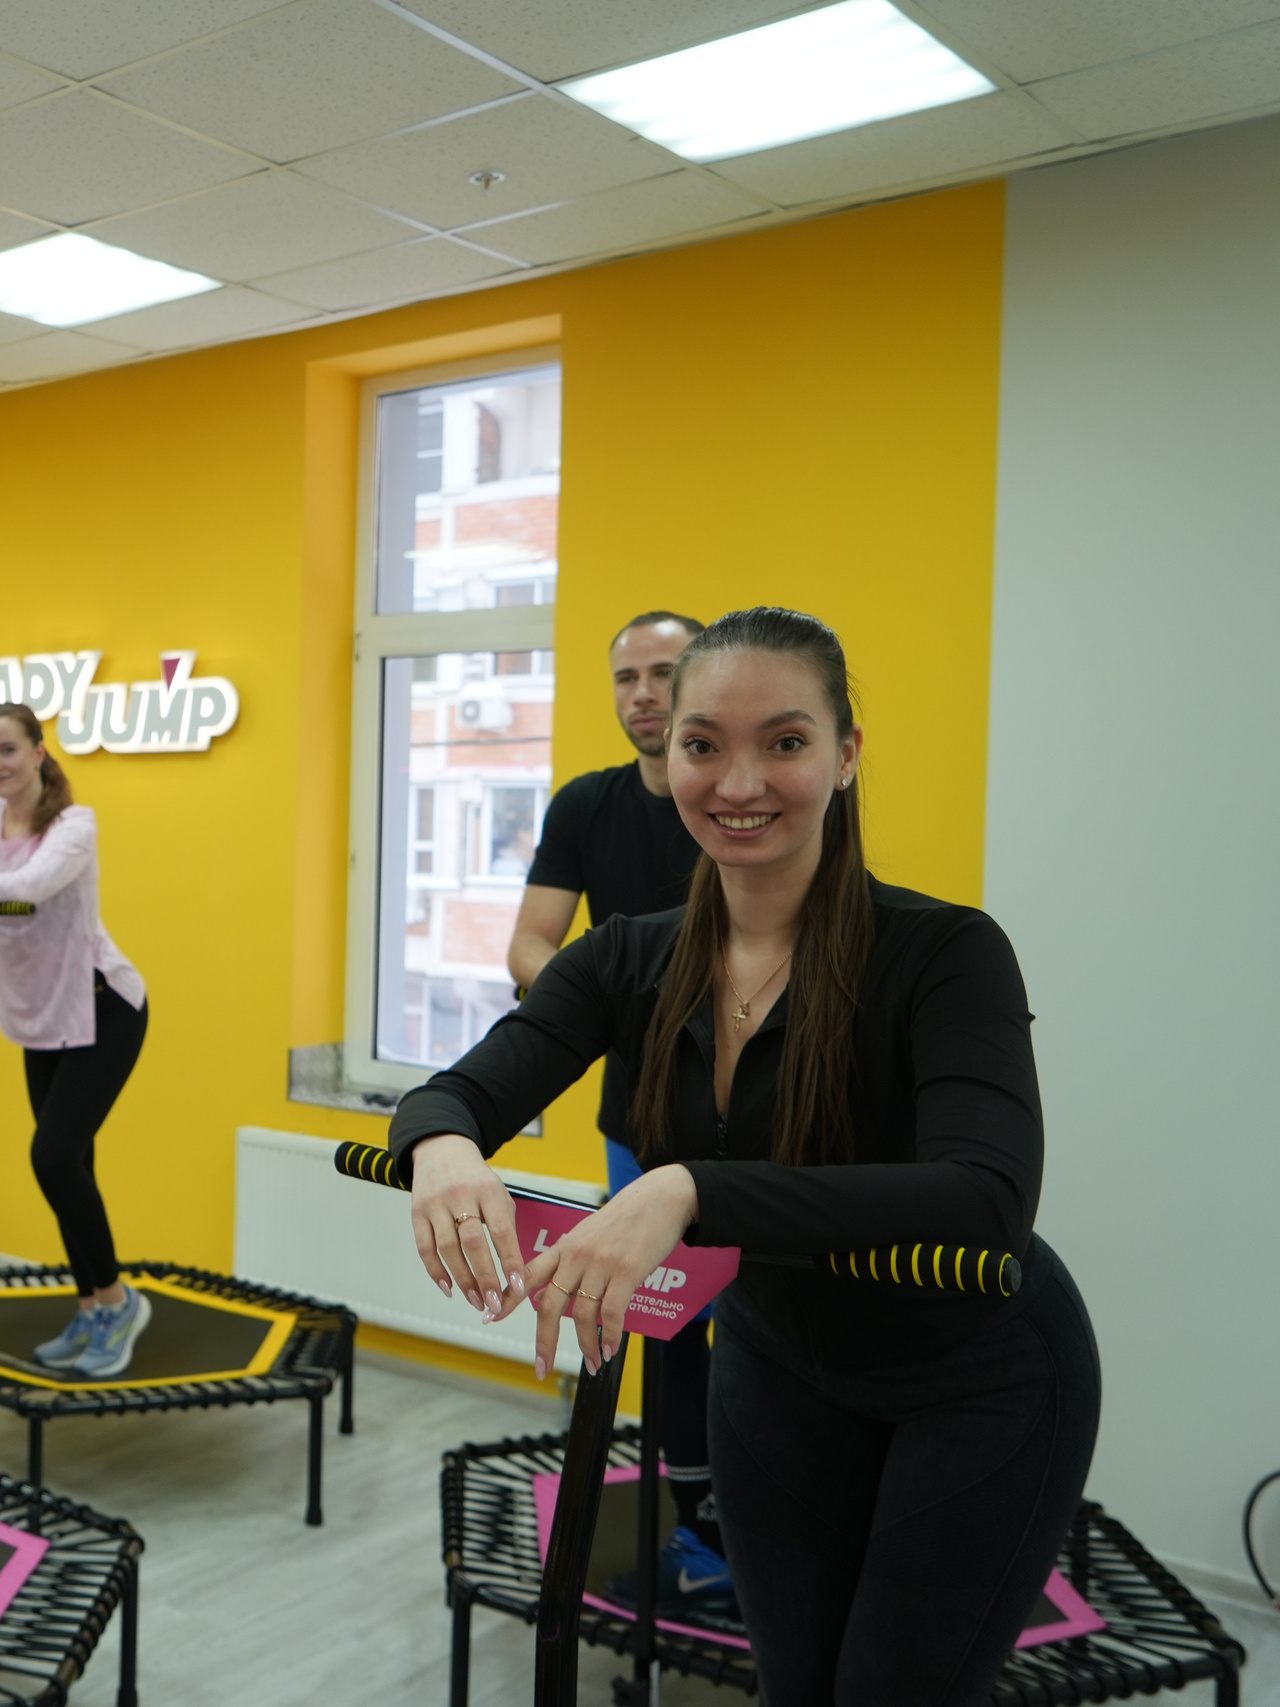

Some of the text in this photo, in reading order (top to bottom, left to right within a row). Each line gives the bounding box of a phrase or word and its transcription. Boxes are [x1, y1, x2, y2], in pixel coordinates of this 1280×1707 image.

[56, 656, 232, 748] JUMP
[642, 1266, 687, 1293] MP
[628, 1302, 677, 1320] ательно
[631, 1293, 684, 1312] гательно
